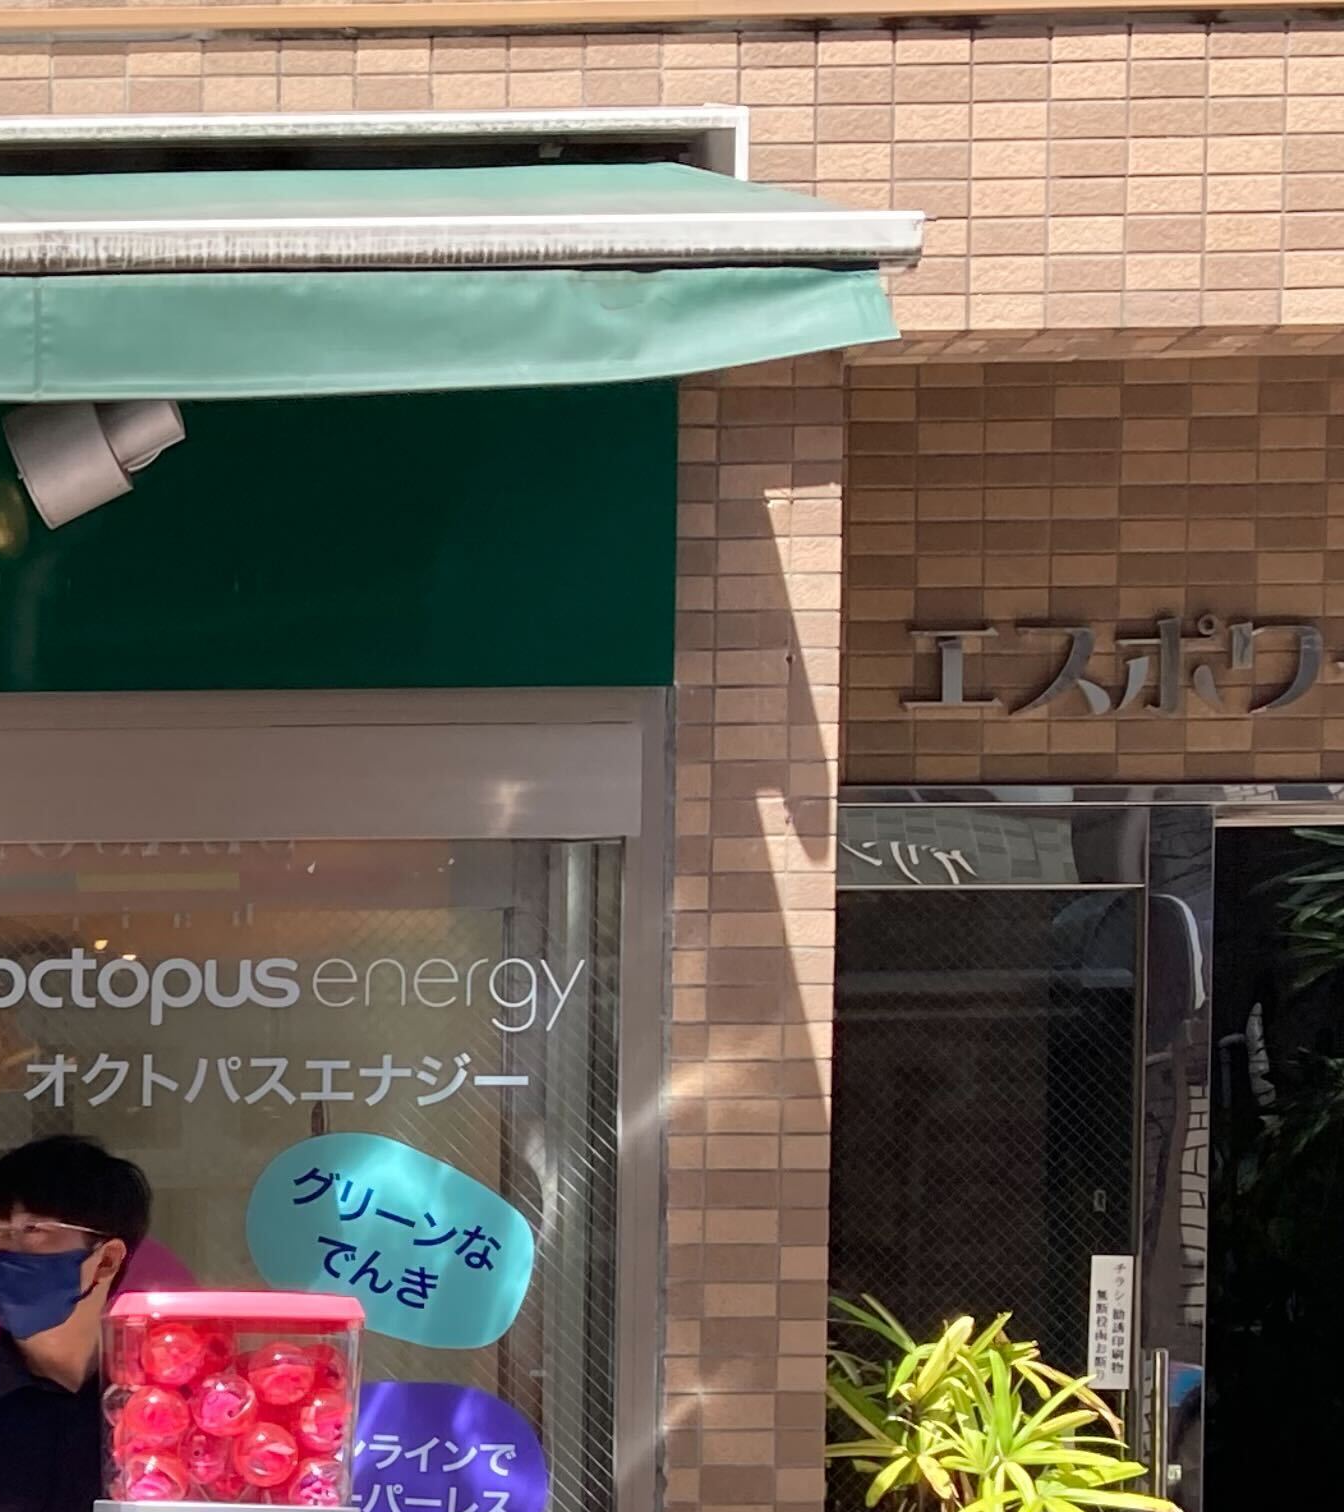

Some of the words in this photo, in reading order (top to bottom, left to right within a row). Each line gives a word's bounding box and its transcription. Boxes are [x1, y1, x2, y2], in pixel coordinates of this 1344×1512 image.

[901, 614, 1344, 715] エスポワ
[312, 956, 586, 1032] energy
[23, 1052, 529, 1106] オクトパスエナジー
[293, 1167, 501, 1271] グリーンな
[318, 1235, 438, 1309] でんき
